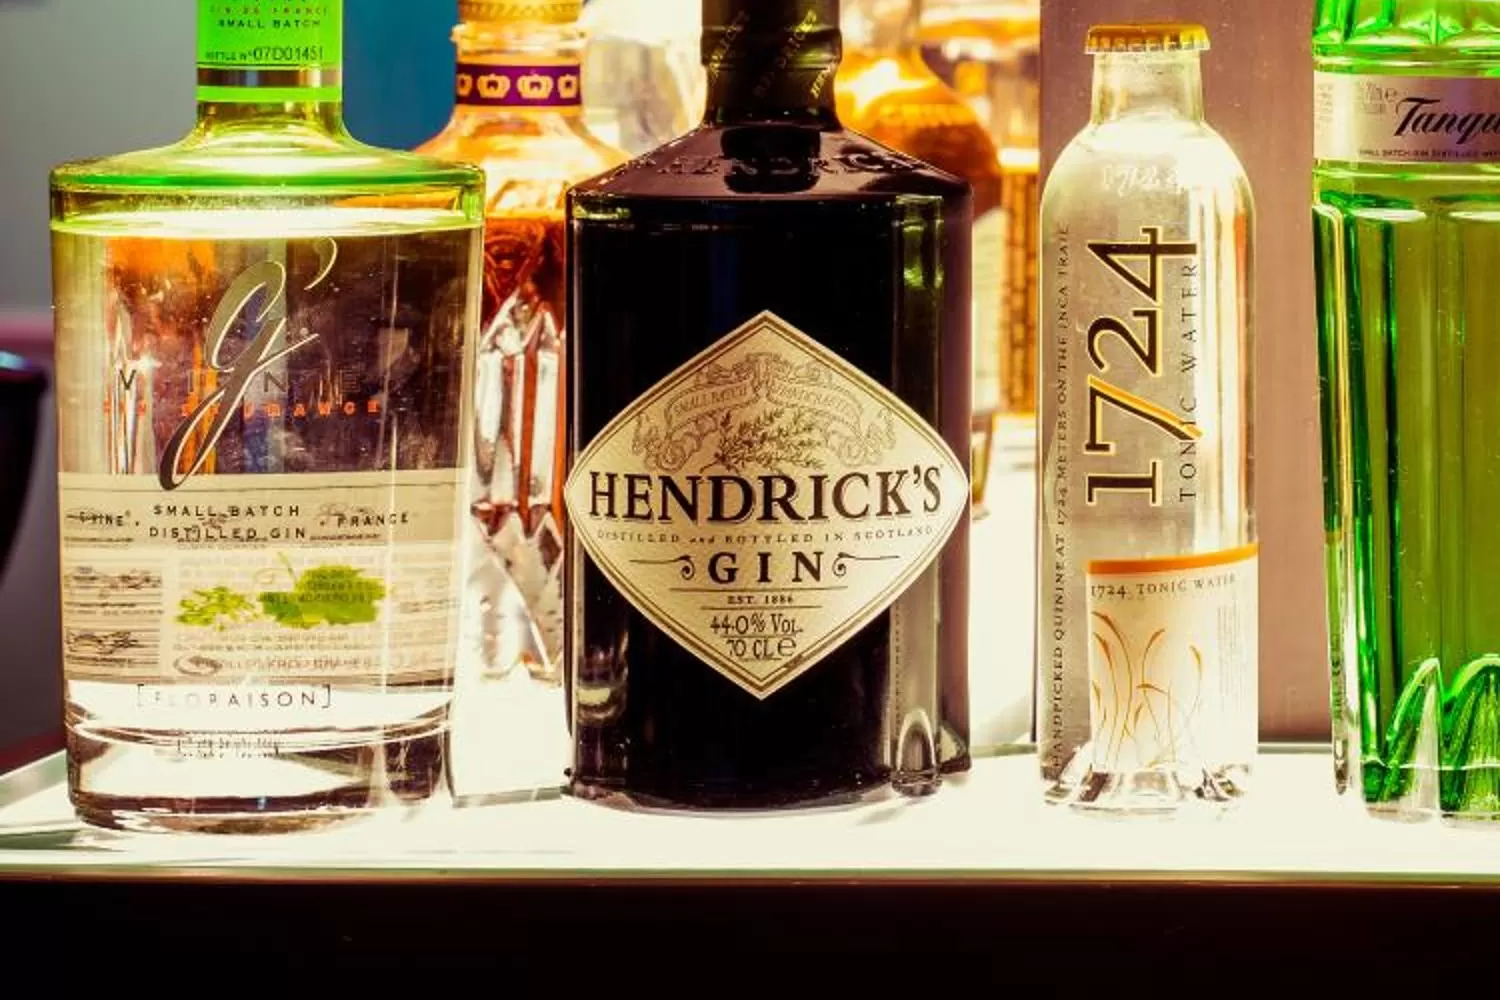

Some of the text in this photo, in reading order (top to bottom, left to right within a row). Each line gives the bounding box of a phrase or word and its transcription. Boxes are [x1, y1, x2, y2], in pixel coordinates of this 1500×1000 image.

[1057, 336, 1068, 373] THE
[1085, 225, 1205, 506] 1724
[1057, 379, 1068, 405] ON
[1179, 262, 1200, 503] TONIC WATER
[589, 464, 942, 523] HENDRICK'S
[153, 504, 217, 518] SMALL
[230, 504, 301, 518] BATCH
[149, 526, 258, 540] DISTILLED
[269, 527, 307, 540] GIN
[597, 529, 679, 544] DISTILLED
[725, 533, 813, 544] BOTTLED
[823, 532, 844, 542] IN
[853, 526, 934, 541] SCOTLAND
[708, 550, 823, 585] GIN
[1136, 578, 1190, 596] TONIC
[725, 639, 748, 658] 70
